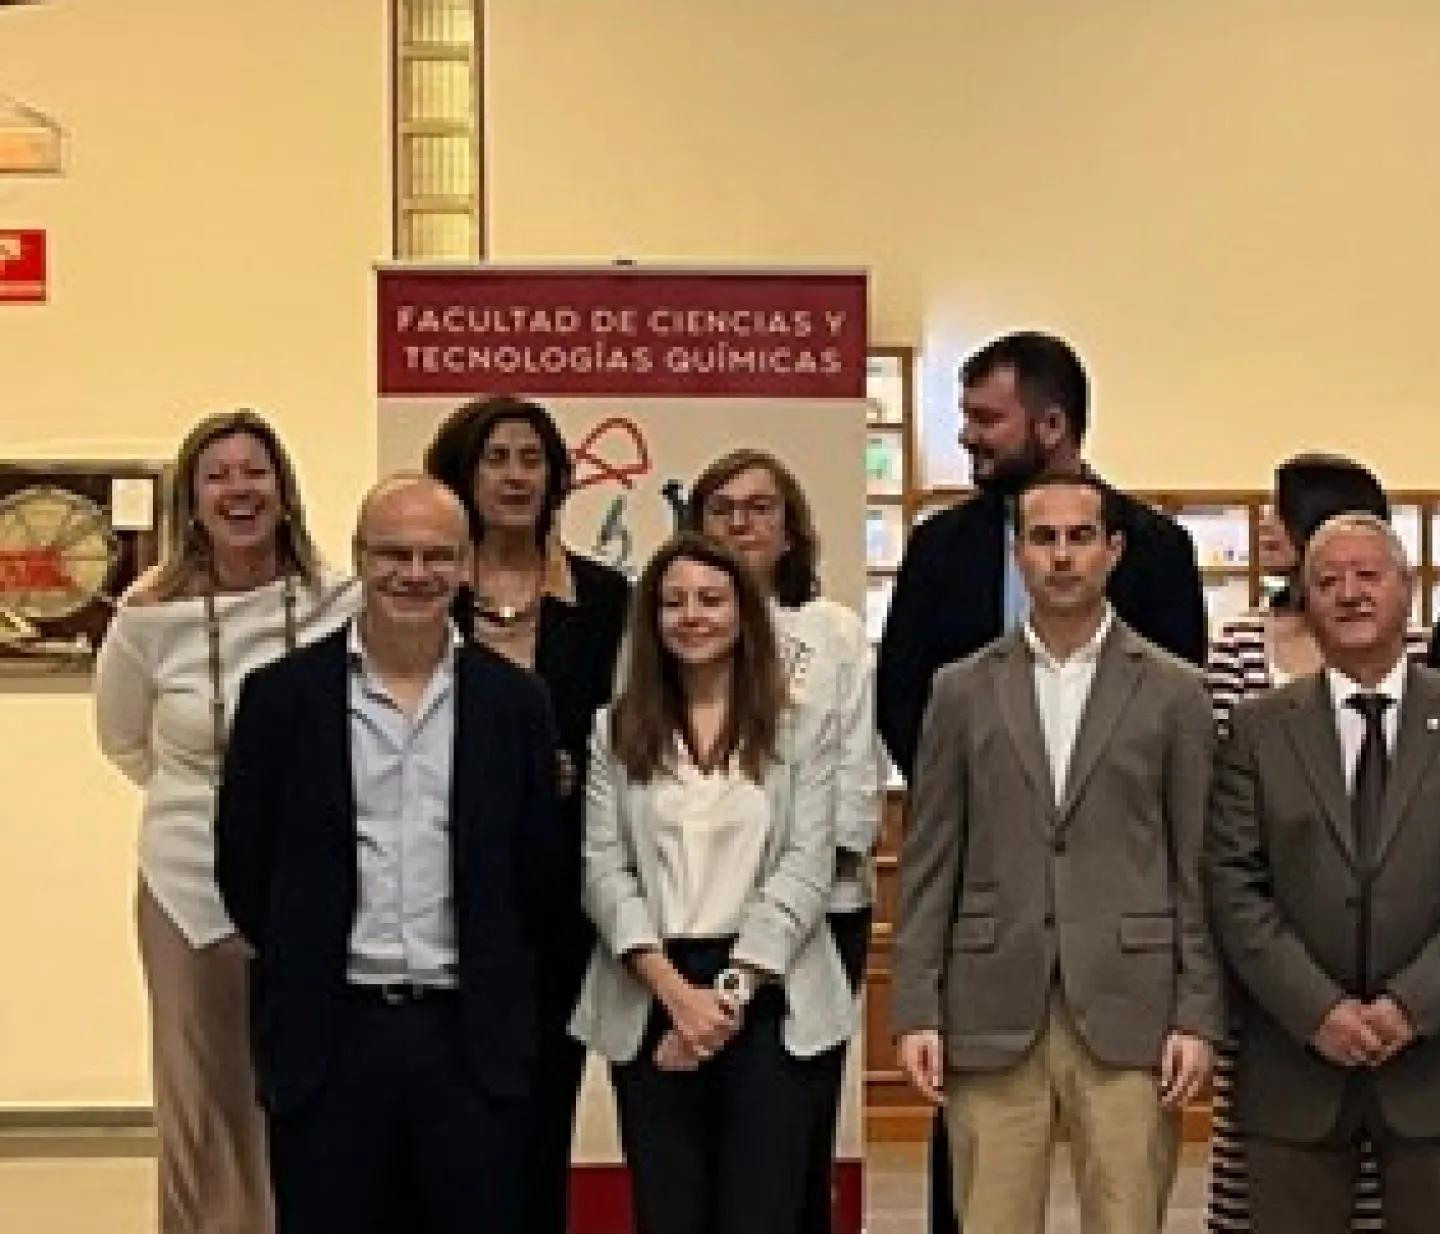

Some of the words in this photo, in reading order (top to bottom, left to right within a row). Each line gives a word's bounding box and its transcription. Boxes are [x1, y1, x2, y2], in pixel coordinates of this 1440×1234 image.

[397, 306, 580, 334] FACULTAD
[591, 309, 638, 336] DE
[647, 309, 812, 337] CIENCIAS
[825, 310, 847, 337] Y
[403, 340, 654, 374] TECNOLOGÍAS
[664, 342, 842, 374] QUÍMICAS
